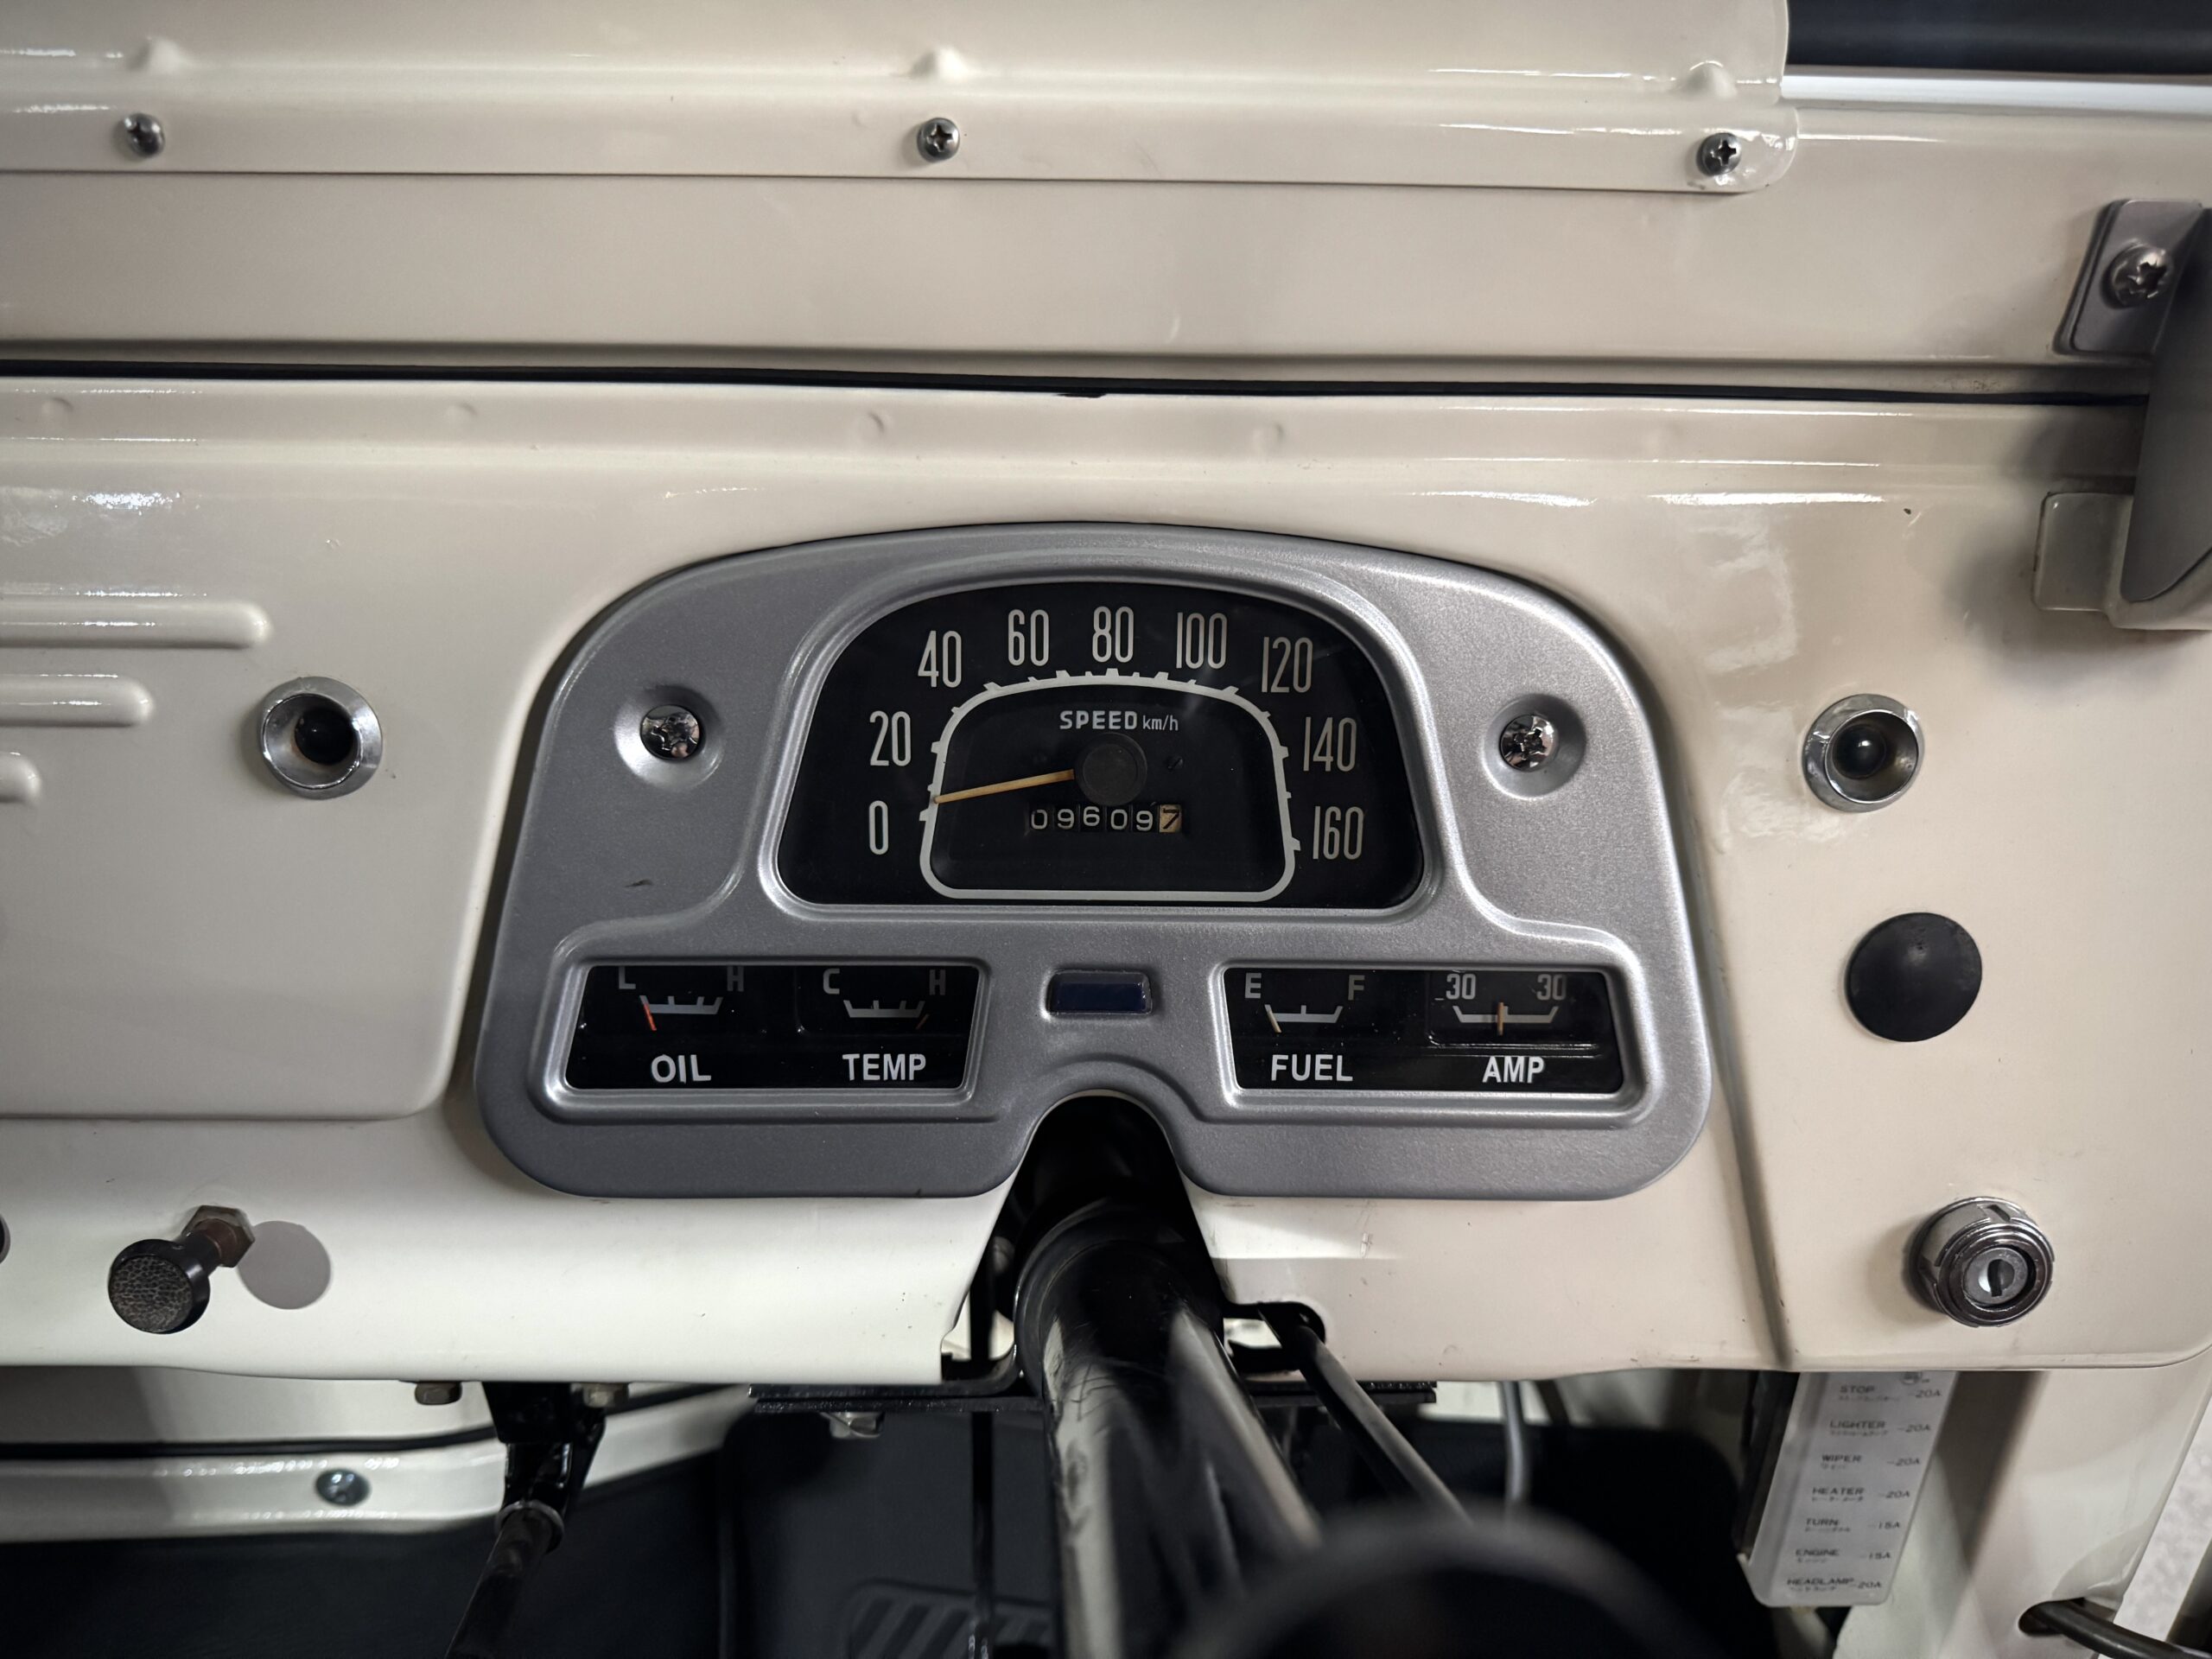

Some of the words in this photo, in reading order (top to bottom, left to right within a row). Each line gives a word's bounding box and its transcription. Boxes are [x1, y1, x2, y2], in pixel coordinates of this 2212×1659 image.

[1008, 610, 1049, 666] 60
[1092, 607, 1134, 663] 80
[1176, 613, 1226, 669] 100
[918, 631, 961, 687] 40
[1262, 637, 1313, 692] 120
[1060, 711, 1137, 729] SPEED
[1143, 715, 1178, 730] km/h
[870, 711, 911, 766] 20
[1304, 717, 1356, 772] 140
[869, 801, 888, 855] 0
[1313, 806, 1363, 859] 160
[619, 968, 636, 989] L
[727, 966, 744, 992] H
[823, 969, 839, 994] C
[930, 969, 945, 995] H
[1245, 973, 1261, 998] E
[1348, 975, 1364, 1000] F
[1537, 974, 1565, 1000] 30
[652, 1054, 711, 1083] OIL
[842, 1054, 925, 1080] TEMP
[1272, 1054, 1352, 1081] FUEL
[1483, 1056, 1544, 1083] AMP
[1840, 1385, 1875, 1394] STOP
[1829, 1421, 1886, 1429] LIGHTER
[1812, 1487, 1864, 1496] HEATER
[1787, 1577, 1854, 1586] HEADLAMP
